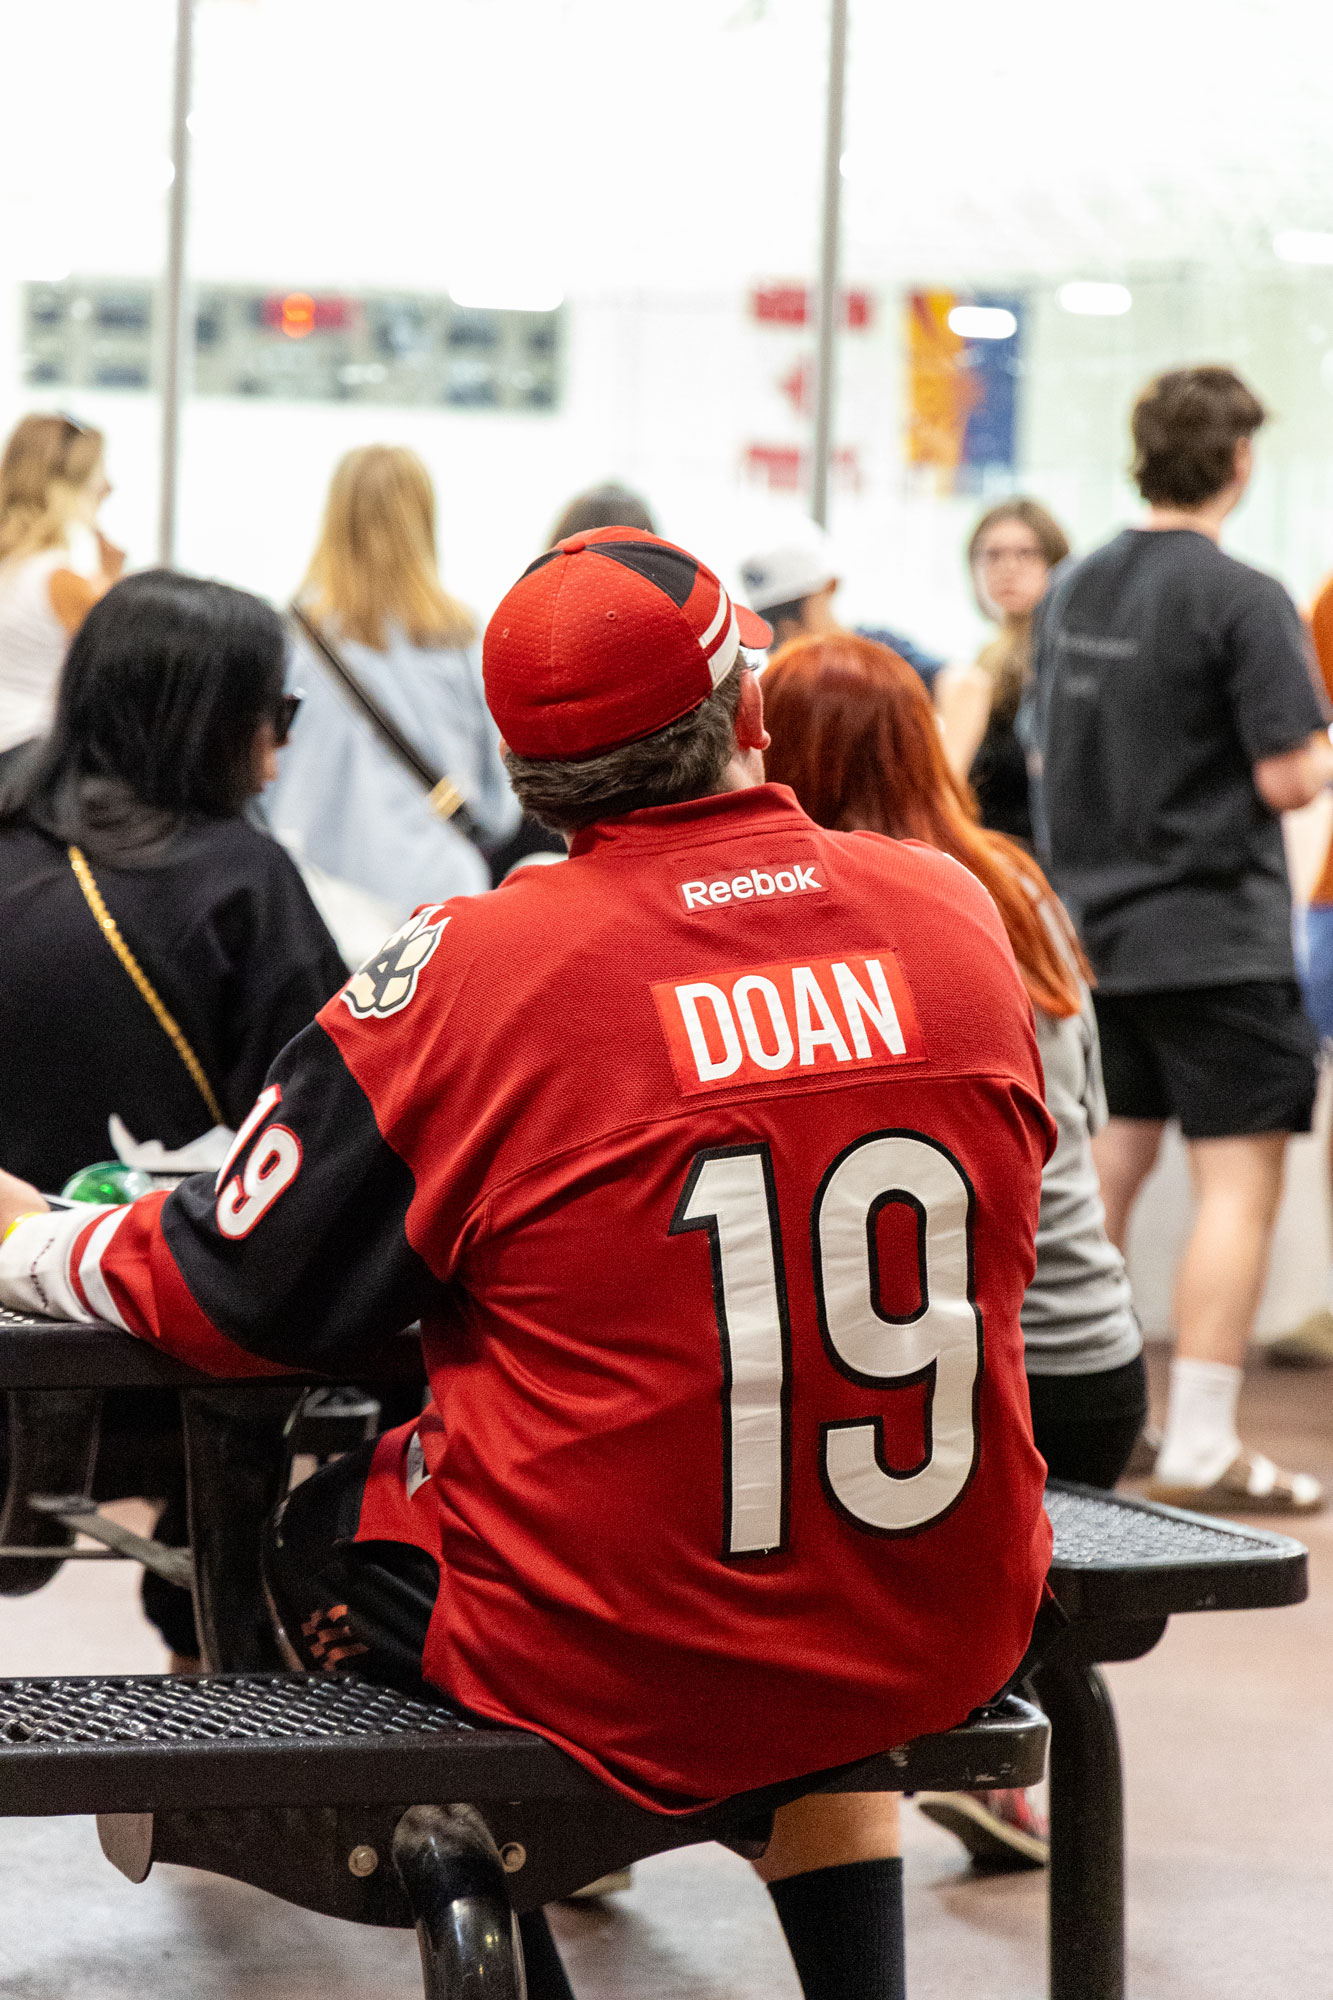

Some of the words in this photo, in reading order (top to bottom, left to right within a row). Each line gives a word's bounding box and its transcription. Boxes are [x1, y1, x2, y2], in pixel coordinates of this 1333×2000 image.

[681, 865, 822, 909] Reebok
[674, 959, 907, 1082] DOAN
[214, 1083, 303, 1240] 19
[668, 1128, 984, 1560] 19
